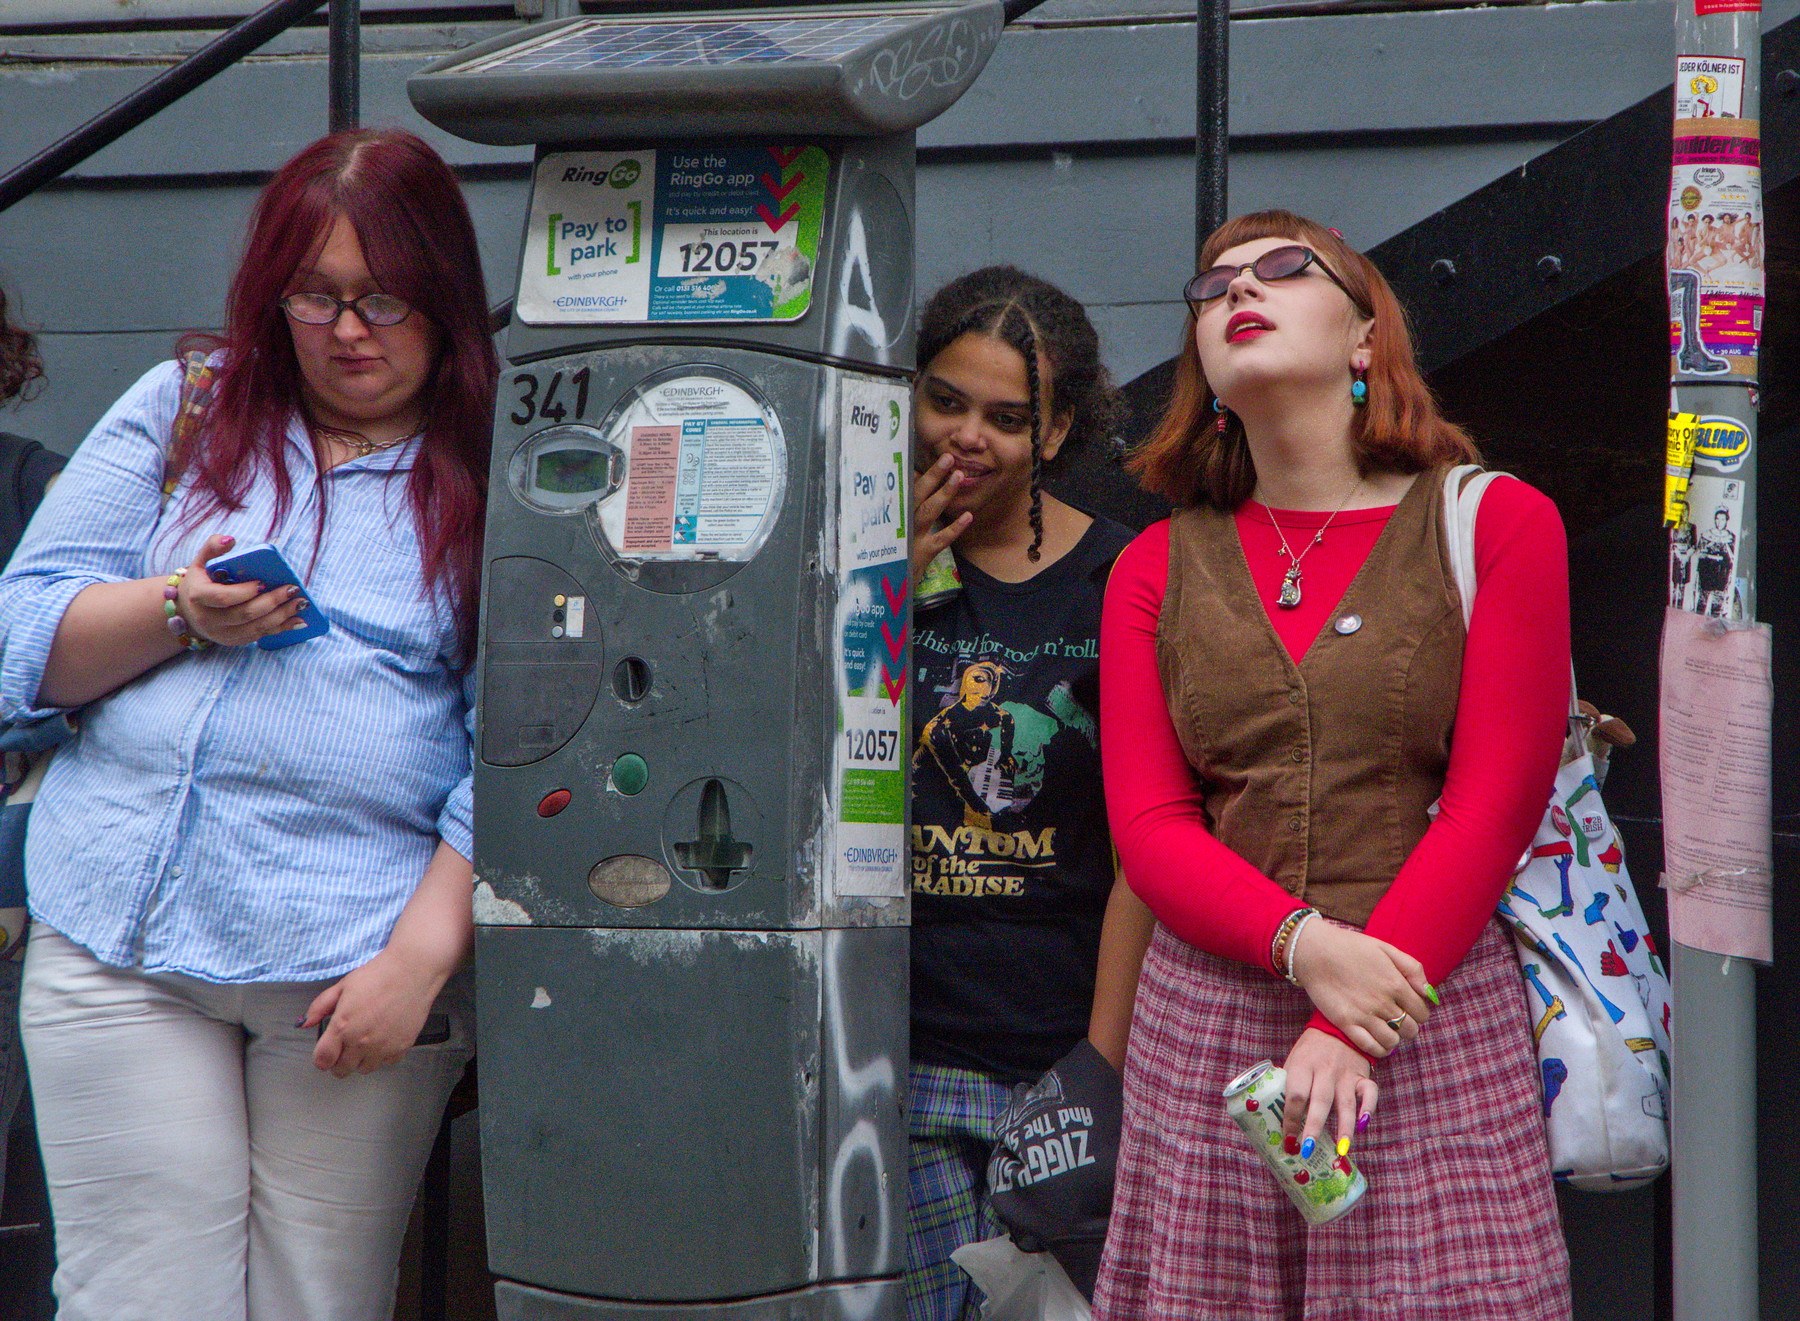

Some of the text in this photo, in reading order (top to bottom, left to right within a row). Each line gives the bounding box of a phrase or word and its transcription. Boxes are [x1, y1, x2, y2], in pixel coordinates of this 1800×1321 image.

[1679, 60, 1741, 74] JEDER KÖLNER IST
[672, 154, 727, 168] Use the
[562, 166, 638, 186] RingGo
[670, 172, 755, 188] RingGo app
[666, 206, 753, 217] It's quick and easy!
[562, 217, 627, 241] Pay to
[703, 227, 758, 236] This location is
[571, 237, 617, 266] park
[680, 240, 779, 273] 12057
[583, 272, 597, 280] your
[598, 269, 618, 277] phone
[510, 366, 591, 426] 341
[853, 471, 876, 497] Pay
[857, 545, 897, 561] with your phone
[871, 604, 885, 618] app
[923, 631, 950, 654] his
[979, 633, 1003, 654] for
[845, 728, 898, 762] 12057
[1582, 823, 1603, 833] IRISH
[912, 855, 980, 874] of the
[912, 873, 1024, 897] RADISE
[1023, 1113, 1056, 1140] The
[1057, 1107, 1094, 1130] And
[1017, 1130, 1096, 1187] ZIGGY
